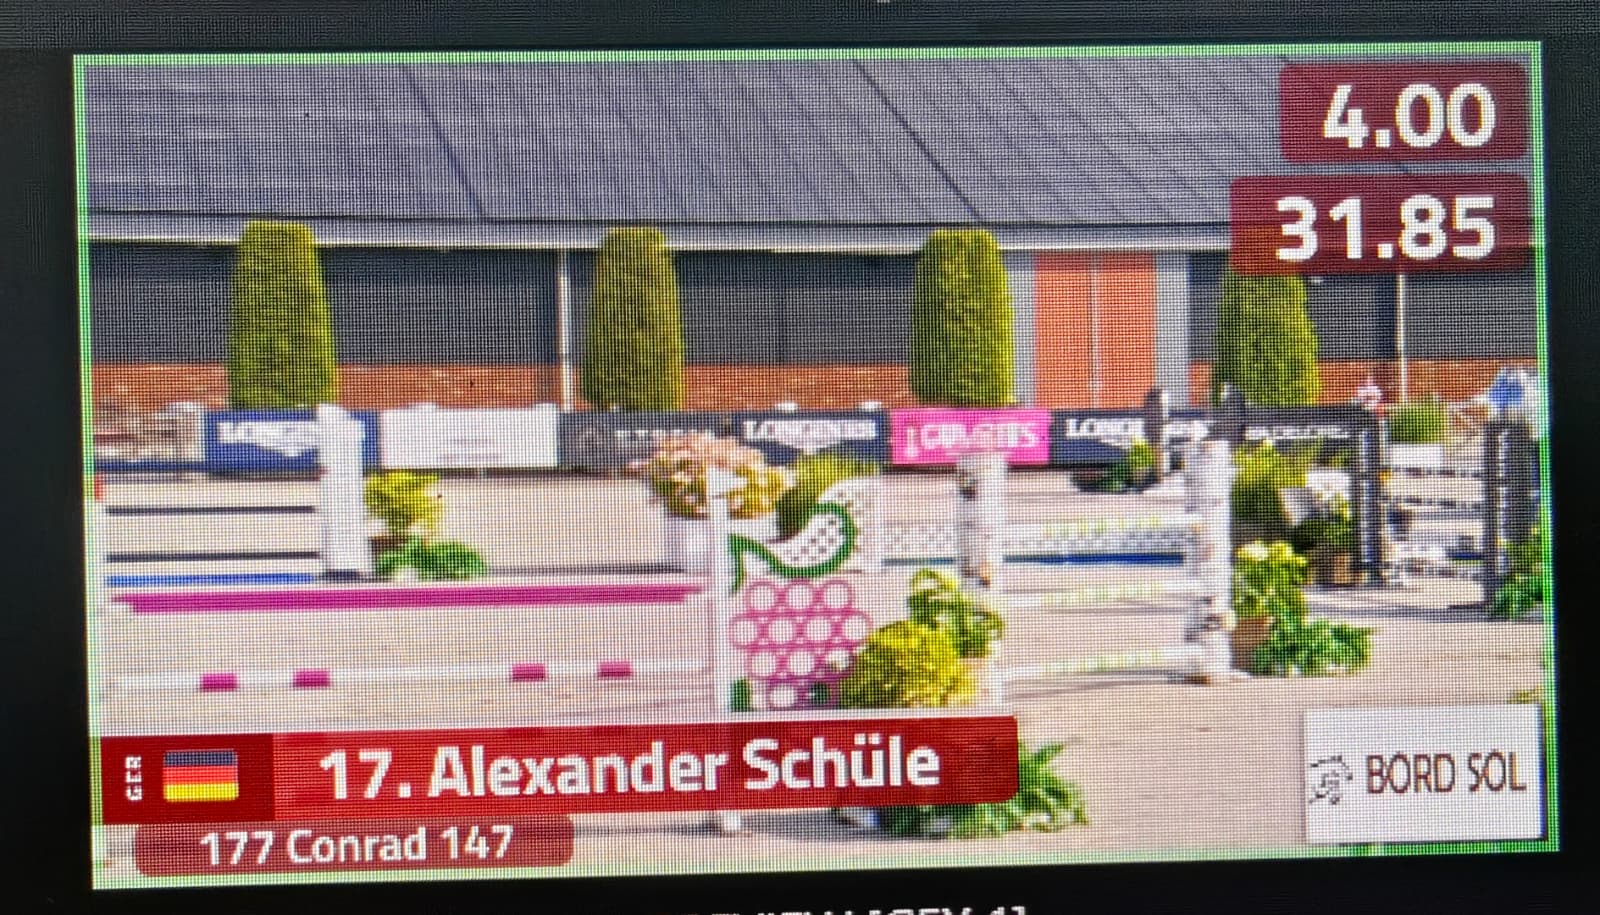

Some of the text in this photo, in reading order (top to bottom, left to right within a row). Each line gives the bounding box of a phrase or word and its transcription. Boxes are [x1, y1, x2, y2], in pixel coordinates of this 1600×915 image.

[1323, 83, 1496, 148] 4.00
[1275, 194, 1496, 260] 31.85
[125, 755, 143, 801] GER
[319, 733, 940, 800] 17. Alexander Schüle
[1366, 749, 1527, 794] BORD SOL
[201, 824, 514, 866] 177 Conrad 147
